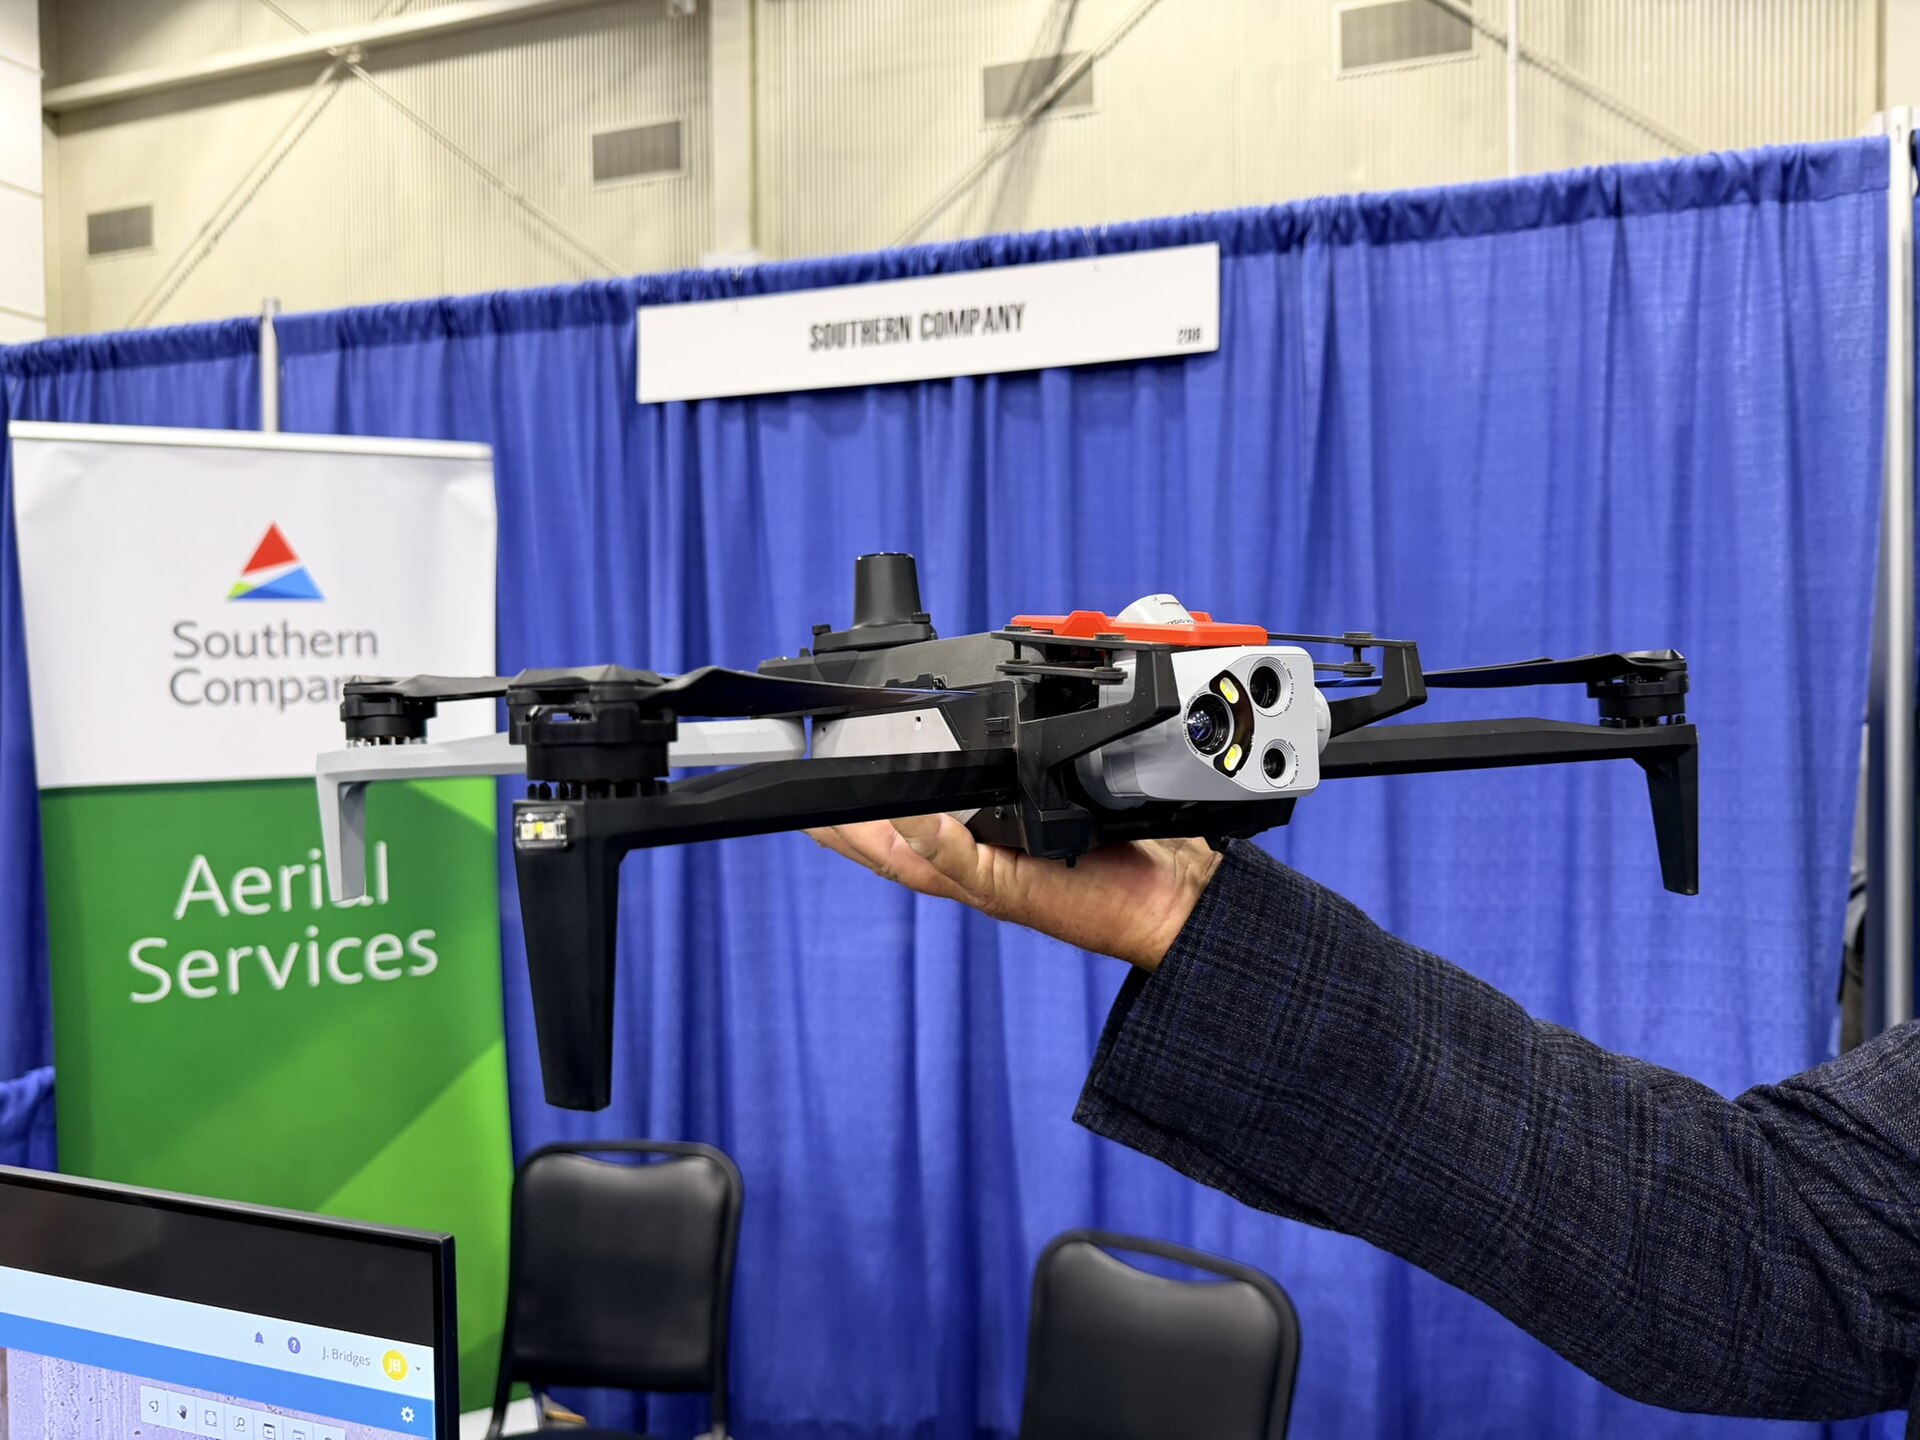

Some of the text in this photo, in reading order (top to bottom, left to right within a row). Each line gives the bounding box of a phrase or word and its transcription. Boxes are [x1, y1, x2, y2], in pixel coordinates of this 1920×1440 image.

[809, 303, 1026, 352] SOUTHERN COMPANY
[171, 619, 379, 659] Southern
[169, 667, 348, 712] Compa
[174, 840, 389, 921] Aeril
[129, 926, 438, 1003] Services
[322, 1347, 370, 1367] J. Bridges
[387, 1358, 402, 1373] JB
